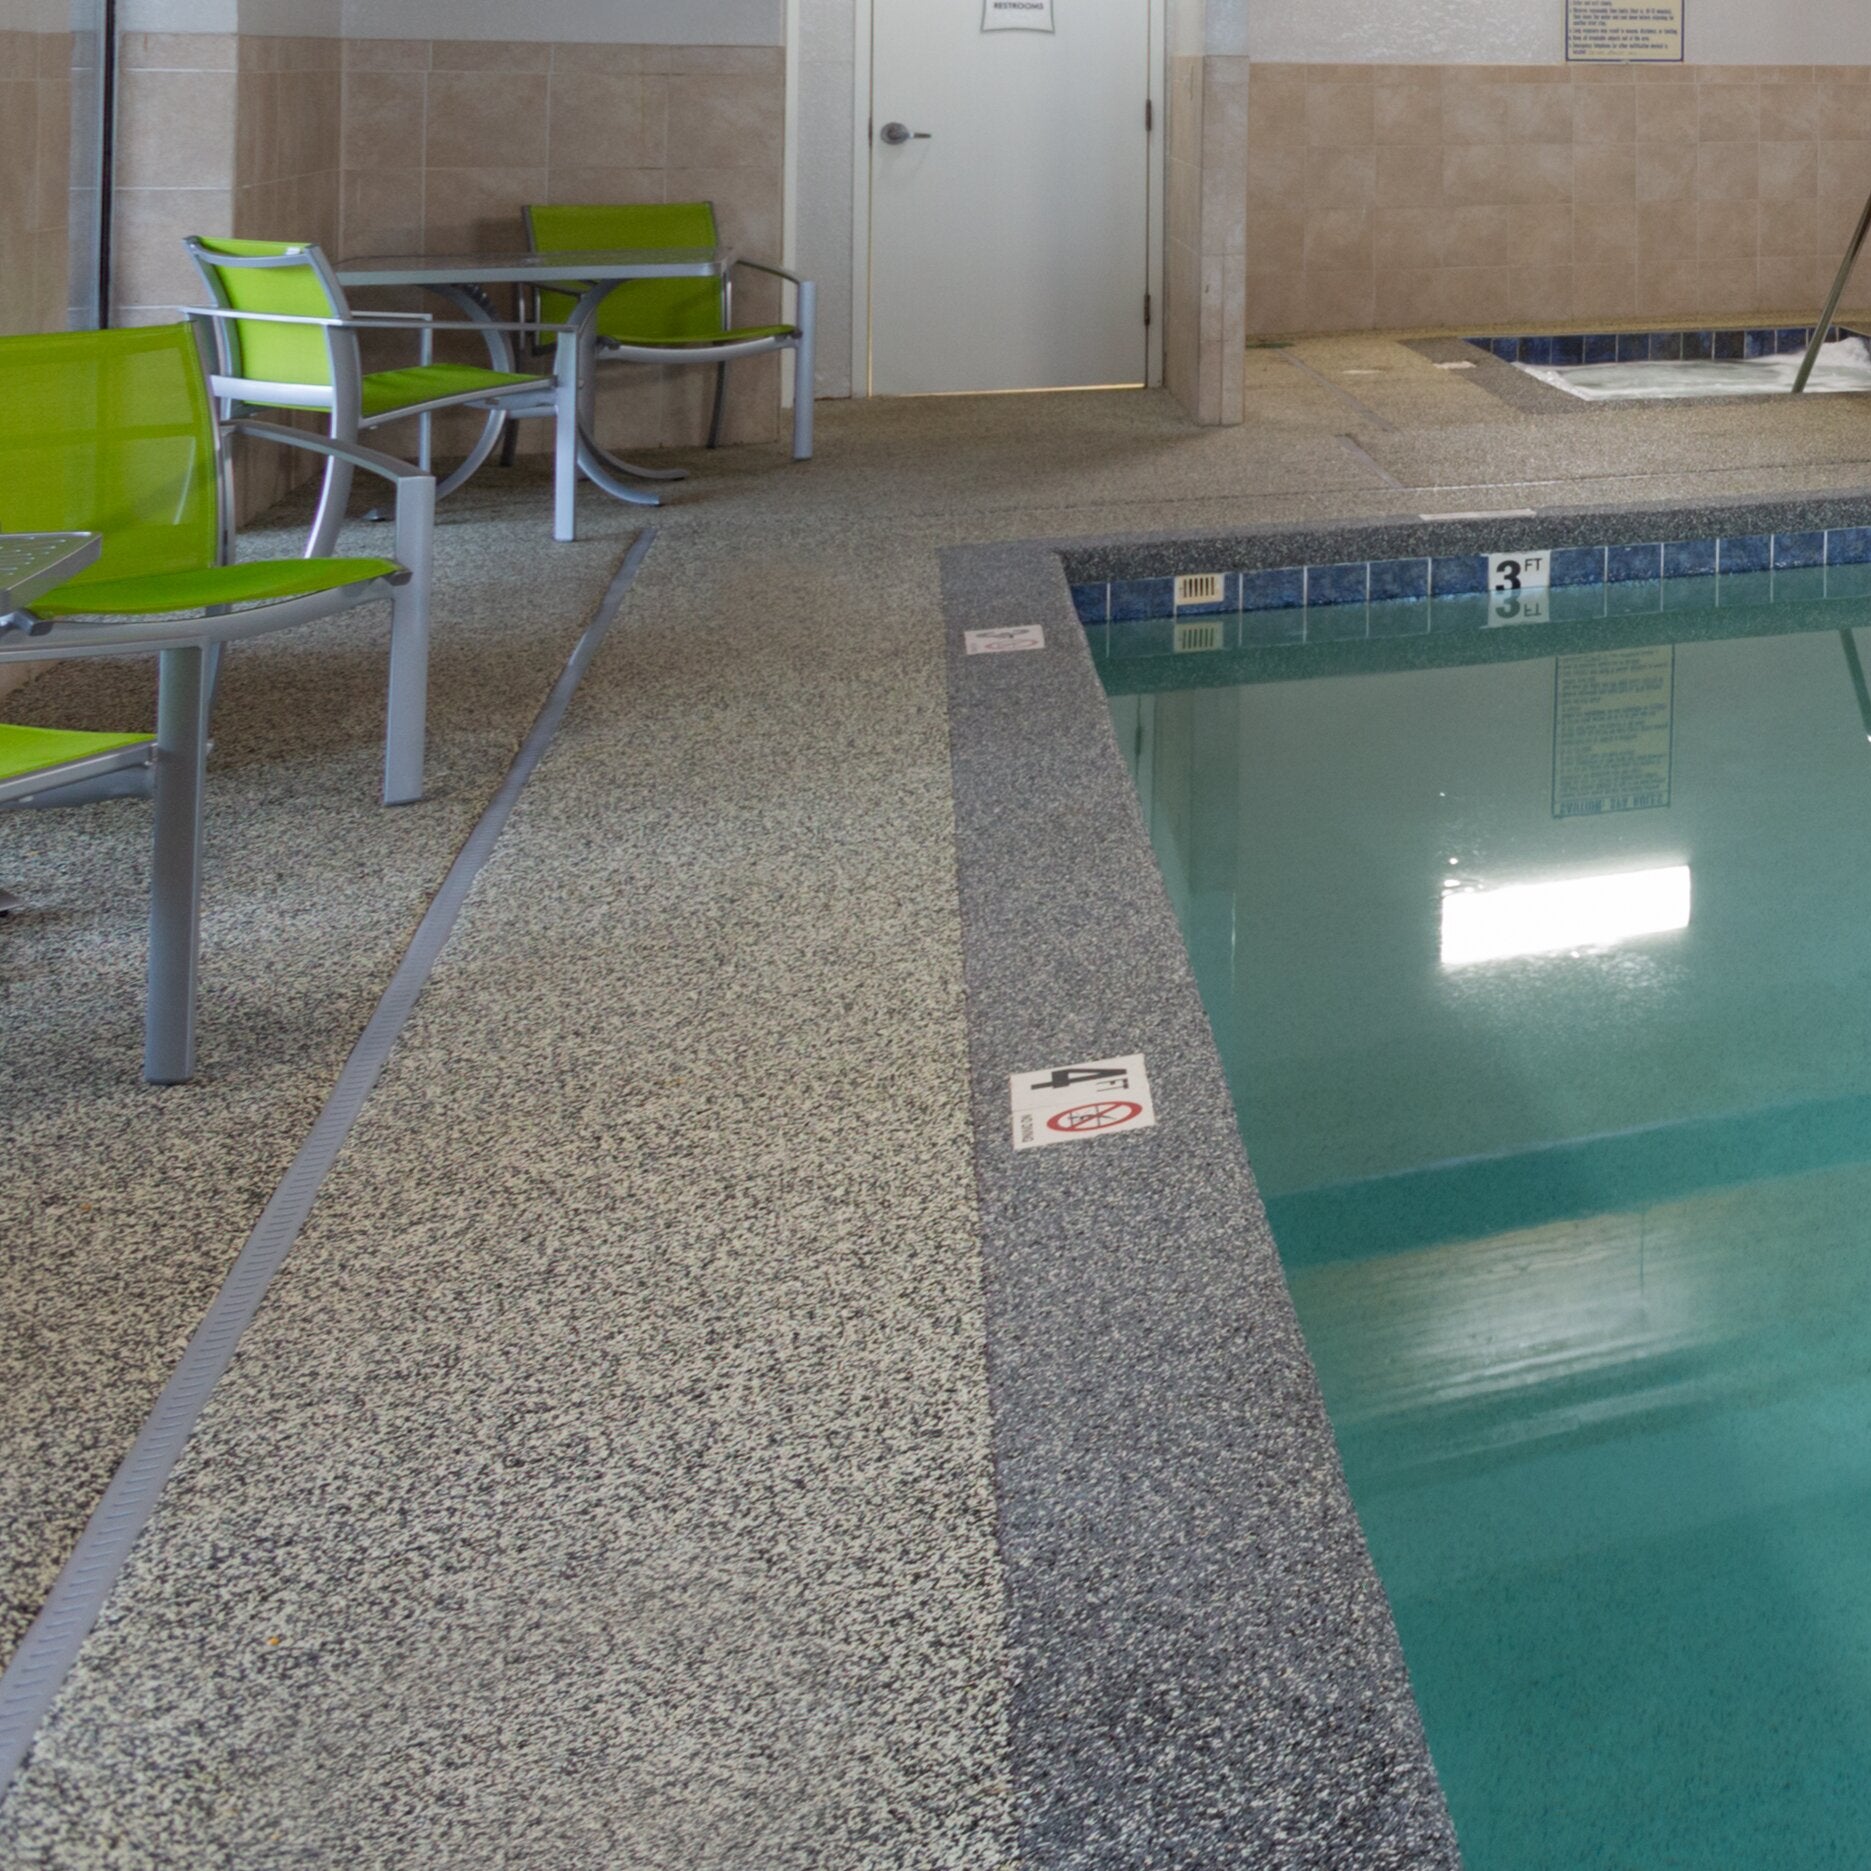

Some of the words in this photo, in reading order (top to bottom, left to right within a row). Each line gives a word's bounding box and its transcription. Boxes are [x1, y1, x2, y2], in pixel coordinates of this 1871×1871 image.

[993, 2, 1044, 10] RESTROOMS
[1496, 560, 1521, 591] 3
[1525, 558, 1542, 572] FT
[1031, 1068, 1127, 1090] 4
